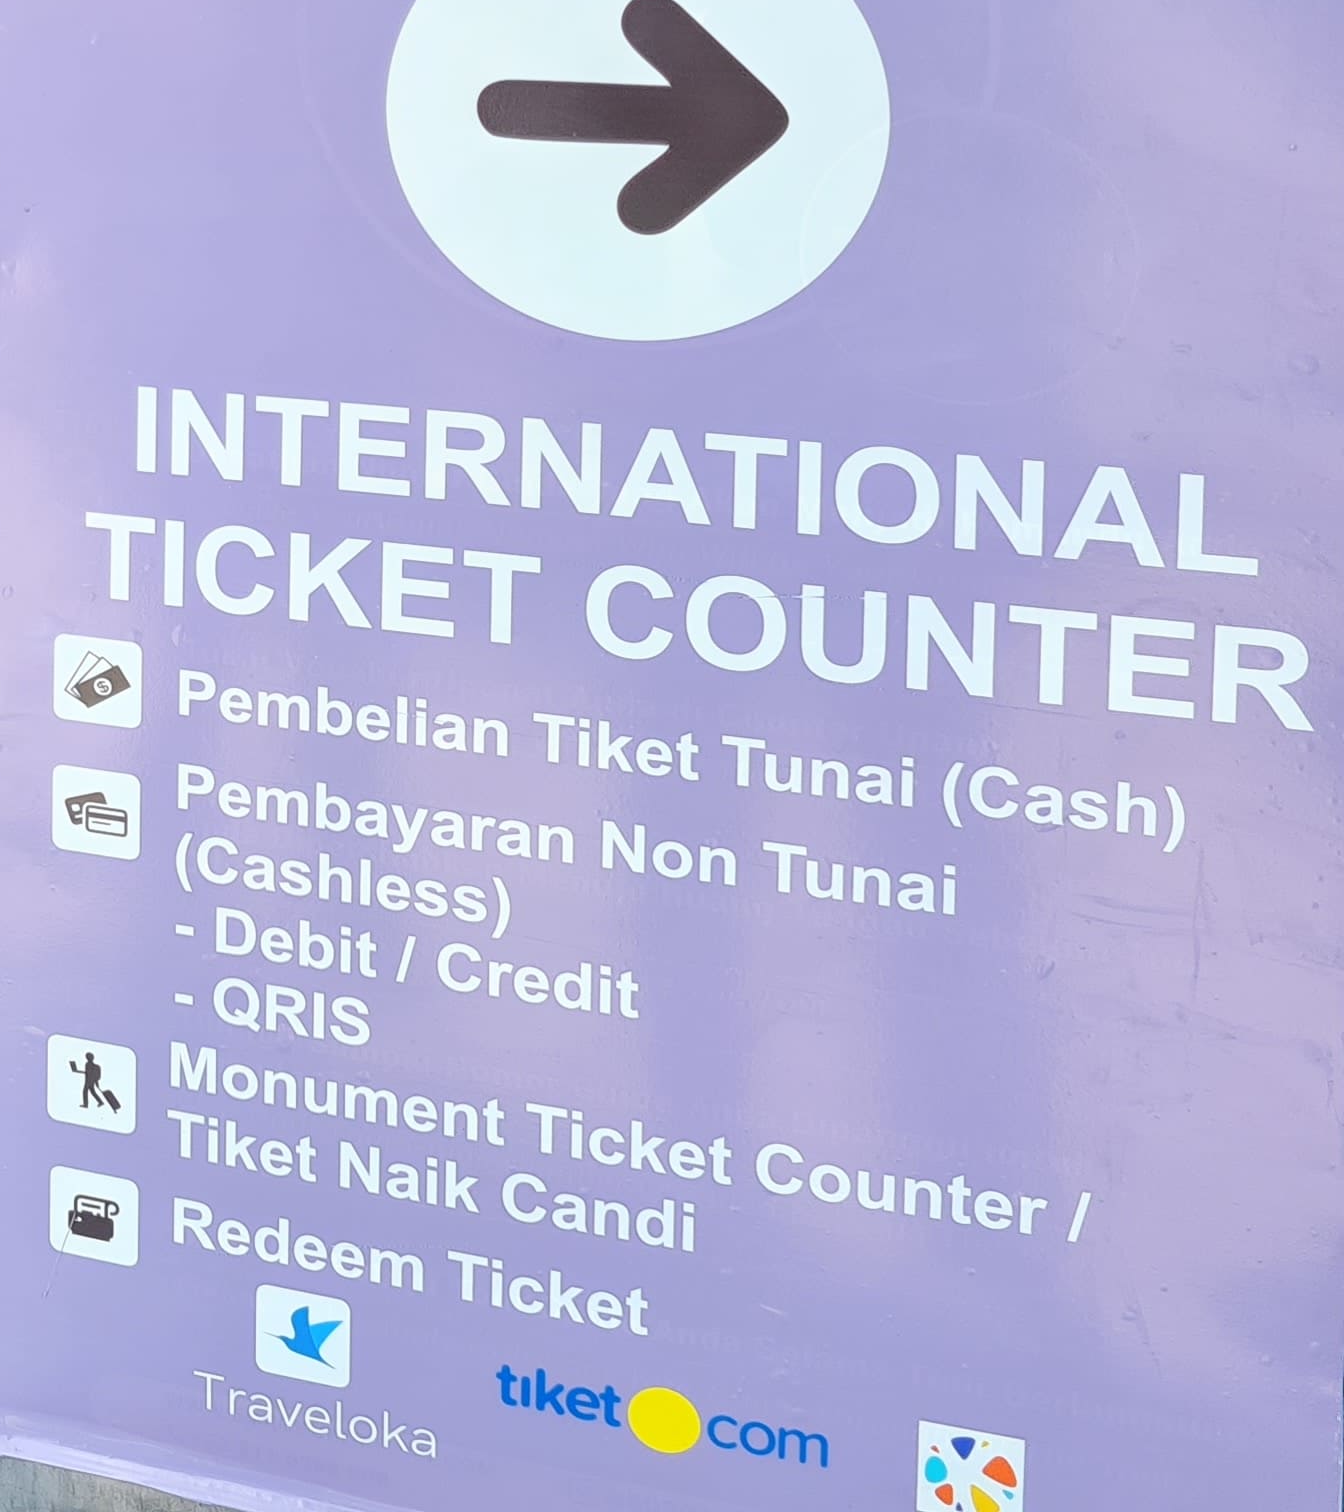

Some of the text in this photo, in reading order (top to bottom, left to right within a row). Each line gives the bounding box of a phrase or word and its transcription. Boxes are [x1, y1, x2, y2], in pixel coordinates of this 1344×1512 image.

[135, 384, 1260, 578] INTERNATIONAL
[83, 510, 1316, 733] TICKET COUNTER
[177, 668, 1186, 854] Pembelian Tiket Tunai (Cash)
[174, 831, 512, 940] (Cashless)
[176, 762, 957, 916] Pembayaran Non Tunai
[212, 976, 371, 1047] QRIS
[214, 905, 378, 979] Debit
[394, 934, 418, 984] /
[436, 941, 640, 1020] Credit
[166, 1108, 695, 1253] Tiket Naik Candi
[169, 1040, 1093, 1244] Monument Ticket Counter /
[172, 1196, 650, 1337] Redeem Ticket
[192, 1369, 437, 1459] Traveloka
